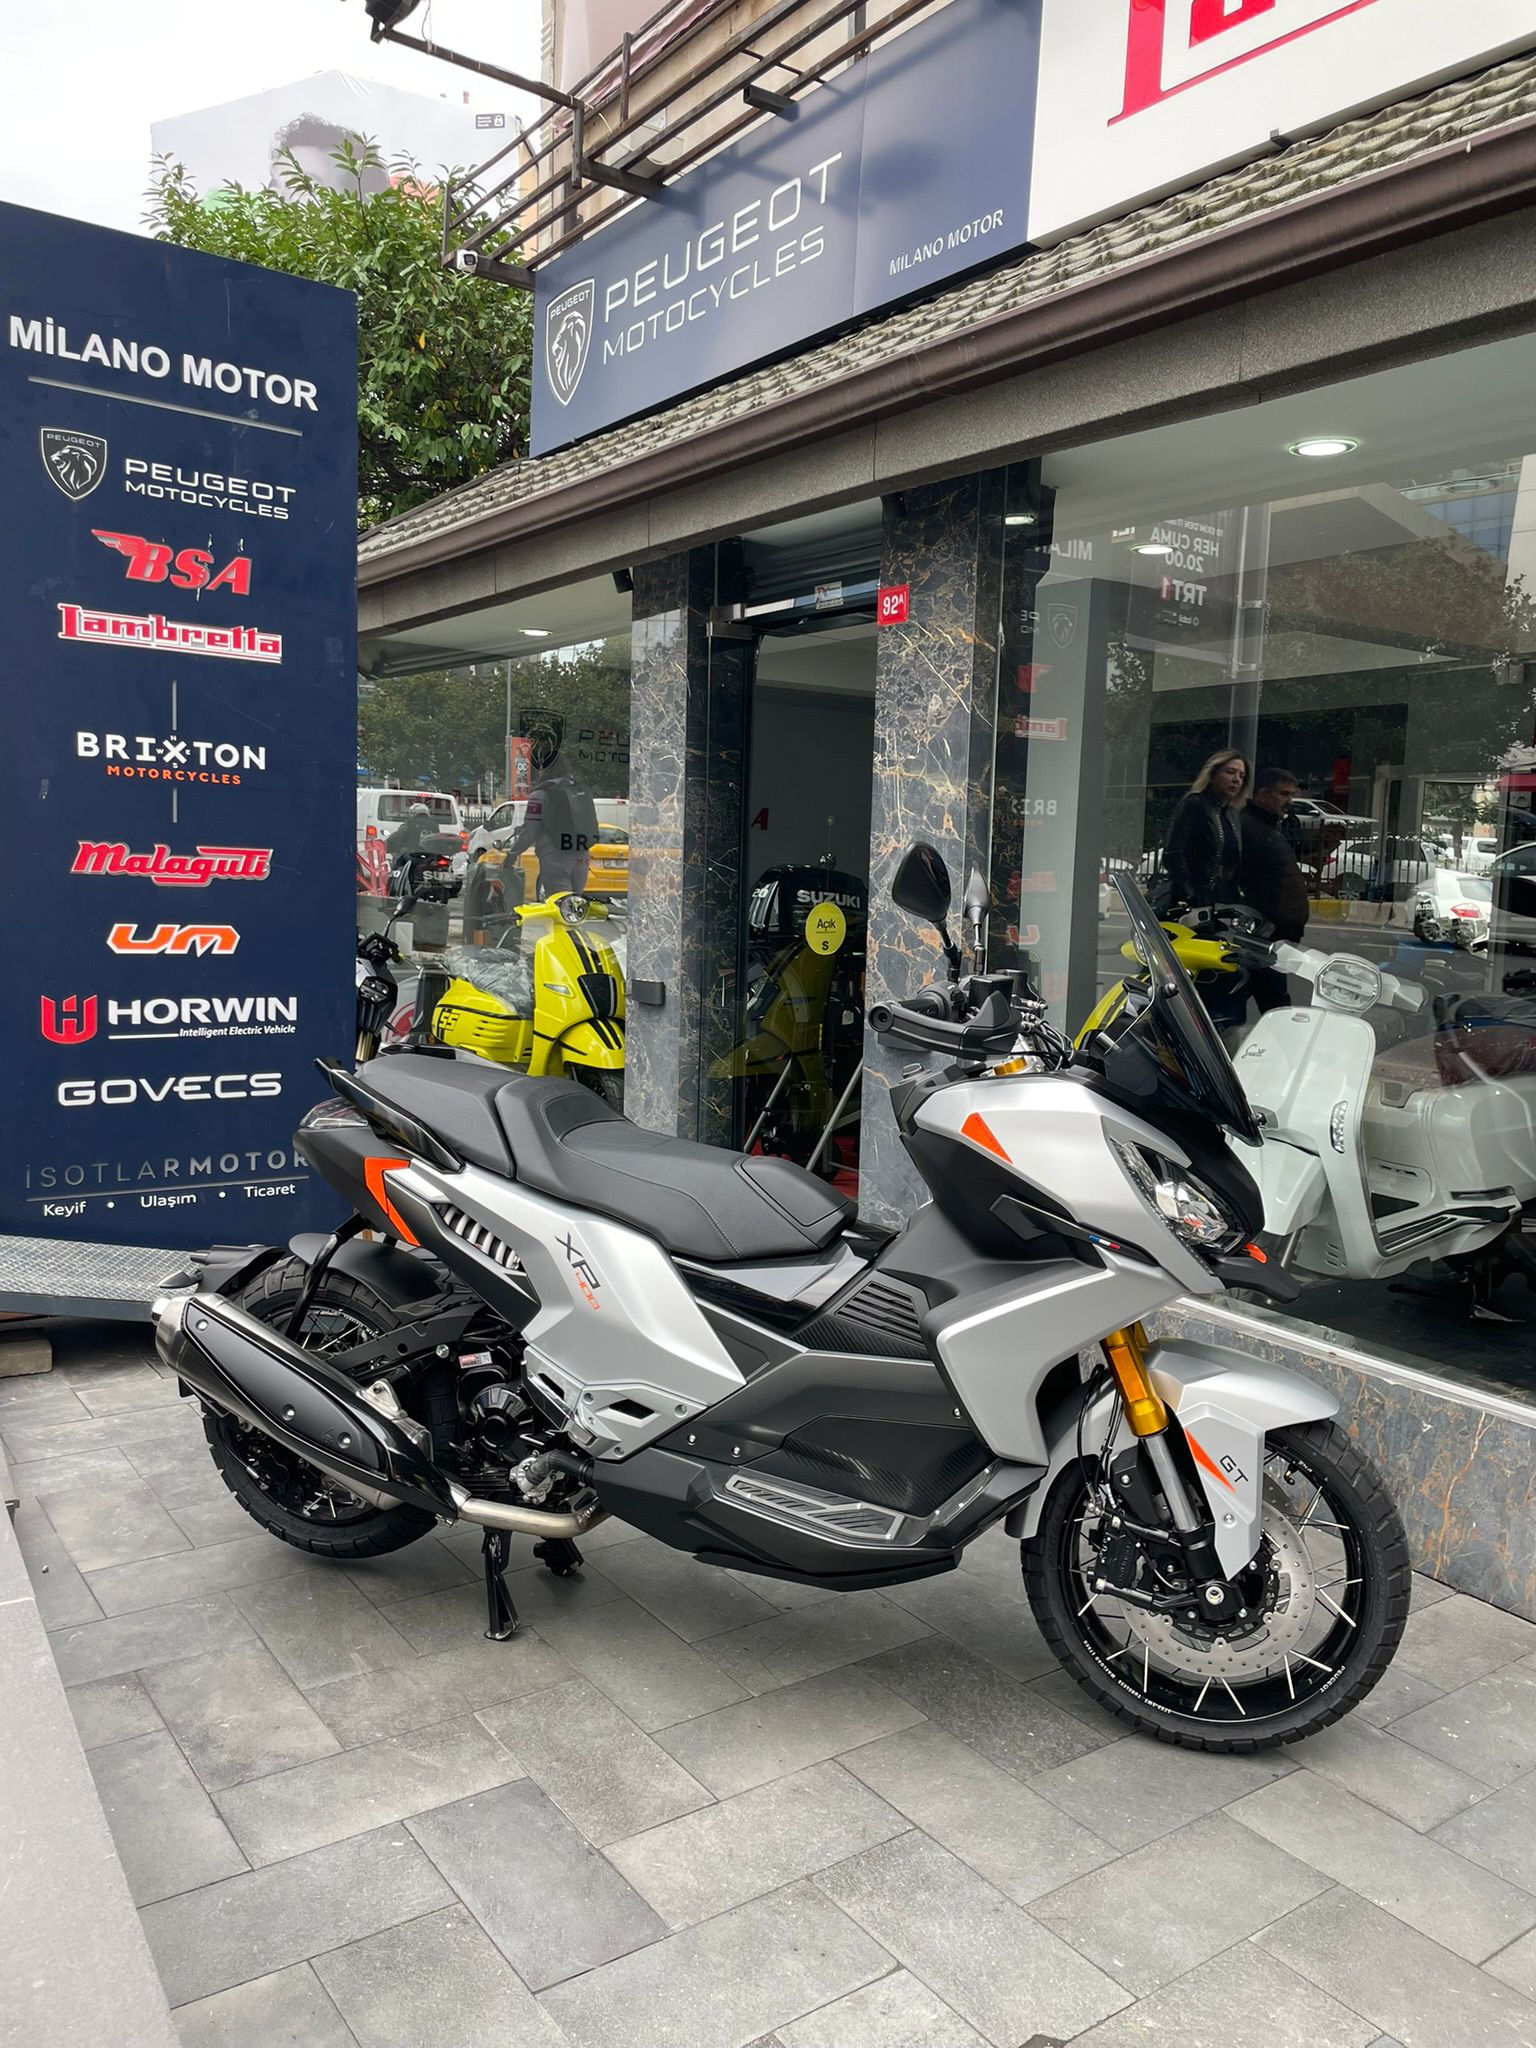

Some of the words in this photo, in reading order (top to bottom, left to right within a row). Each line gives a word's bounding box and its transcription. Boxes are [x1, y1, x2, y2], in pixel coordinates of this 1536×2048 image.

[603, 151, 843, 324] PEUGEOT
[947, 208, 1004, 250] MOTOR
[550, 289, 591, 321] PEUGEOT
[602, 224, 826, 366] MOTOCYCLES
[9, 315, 171, 379] MİLANO
[182, 353, 320, 412] MOTOR
[46, 432, 102, 449] PEUGEOT
[125, 457, 297, 504] PEUGEOT
[125, 480, 290, 521] MOTOCYCLES
[125, 541, 254, 597] BSA
[58, 602, 283, 664] Lambretta
[76, 731, 267, 770] BRIXTON
[107, 765, 242, 785] MOTORCYCLES
[70, 840, 274, 888] Malaguti
[796, 889, 861, 909] SUZUKI
[108, 996, 298, 1025] HORWIN
[180, 1027, 228, 1039] Intelligent
[229, 1025, 263, 1036] Electric
[264, 1024, 297, 1035] Vehicle
[58, 1072, 283, 1107] GOVECS
[43, 1200, 87, 1218] Keyif
[140, 1192, 198, 1209] Ulaşım
[243, 1183, 297, 1199] Ticaret
[555, 1232, 602, 1289] XP
[1219, 1454, 1249, 1483] GT
[1319, 1664, 1347, 1694] PEUGEOT
